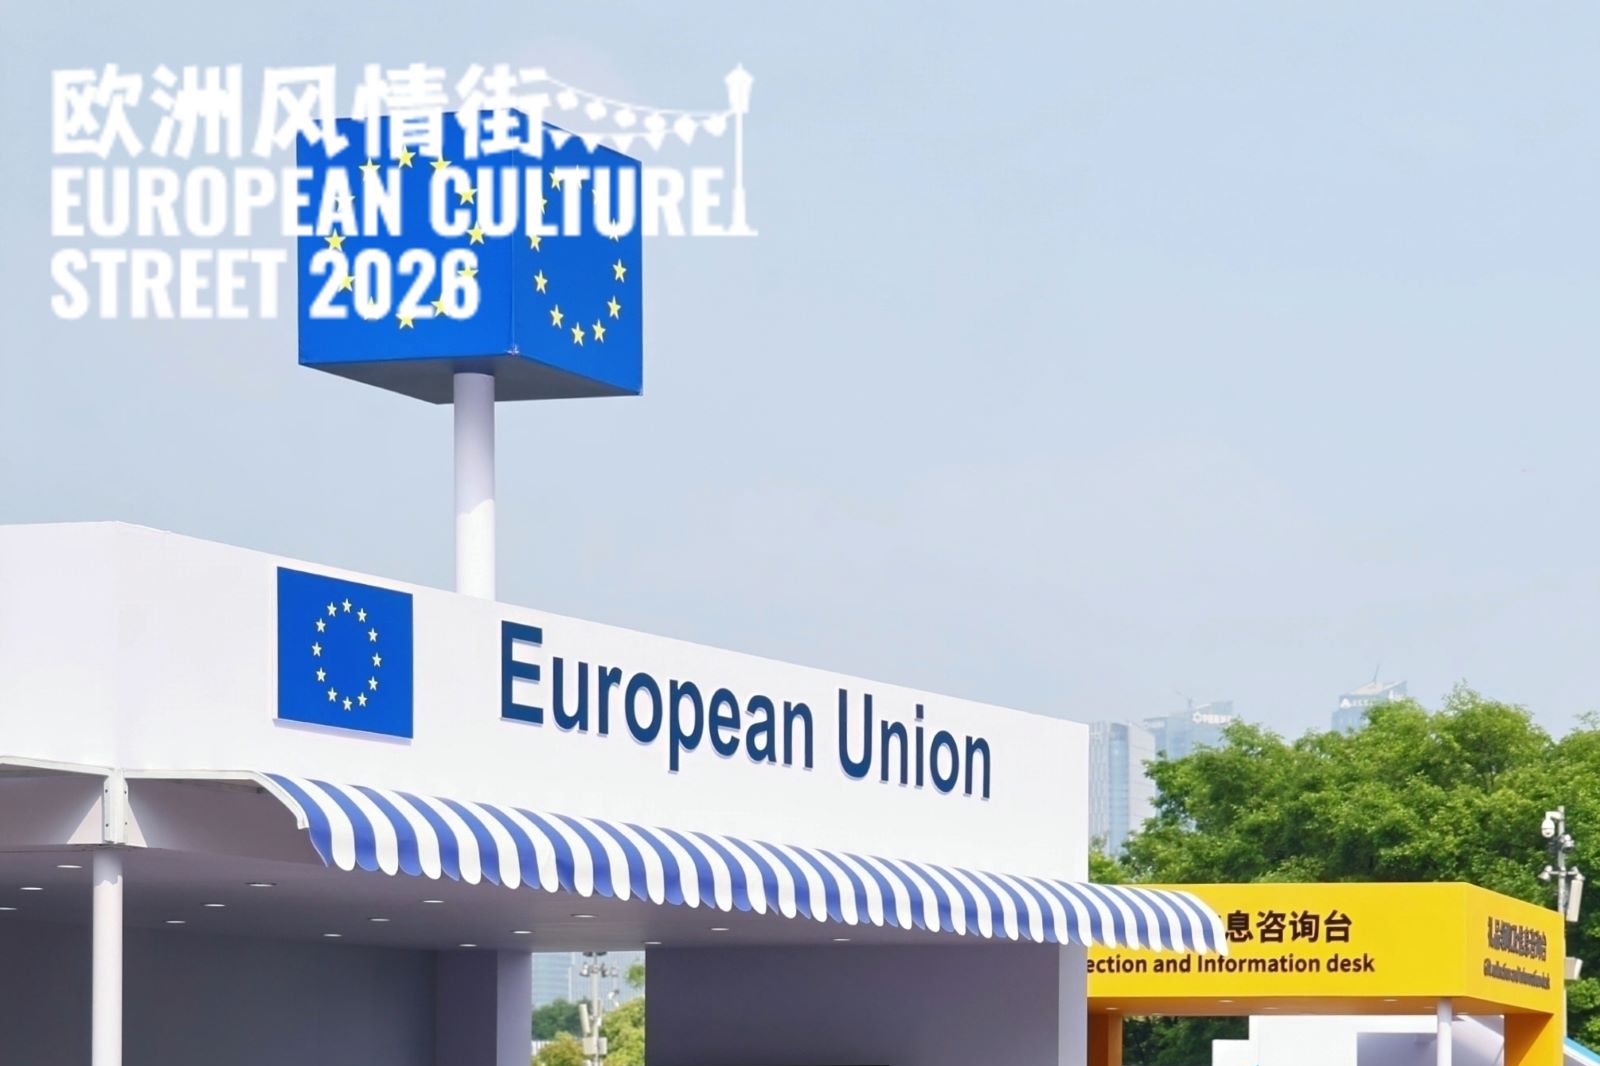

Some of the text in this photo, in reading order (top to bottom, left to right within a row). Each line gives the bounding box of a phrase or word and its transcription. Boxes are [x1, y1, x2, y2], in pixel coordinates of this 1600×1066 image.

[500, 619, 992, 799] European Union
[1153, 953, 1192, 974] and
[1197, 953, 1321, 974] Information
[1326, 953, 1376, 974] desk
